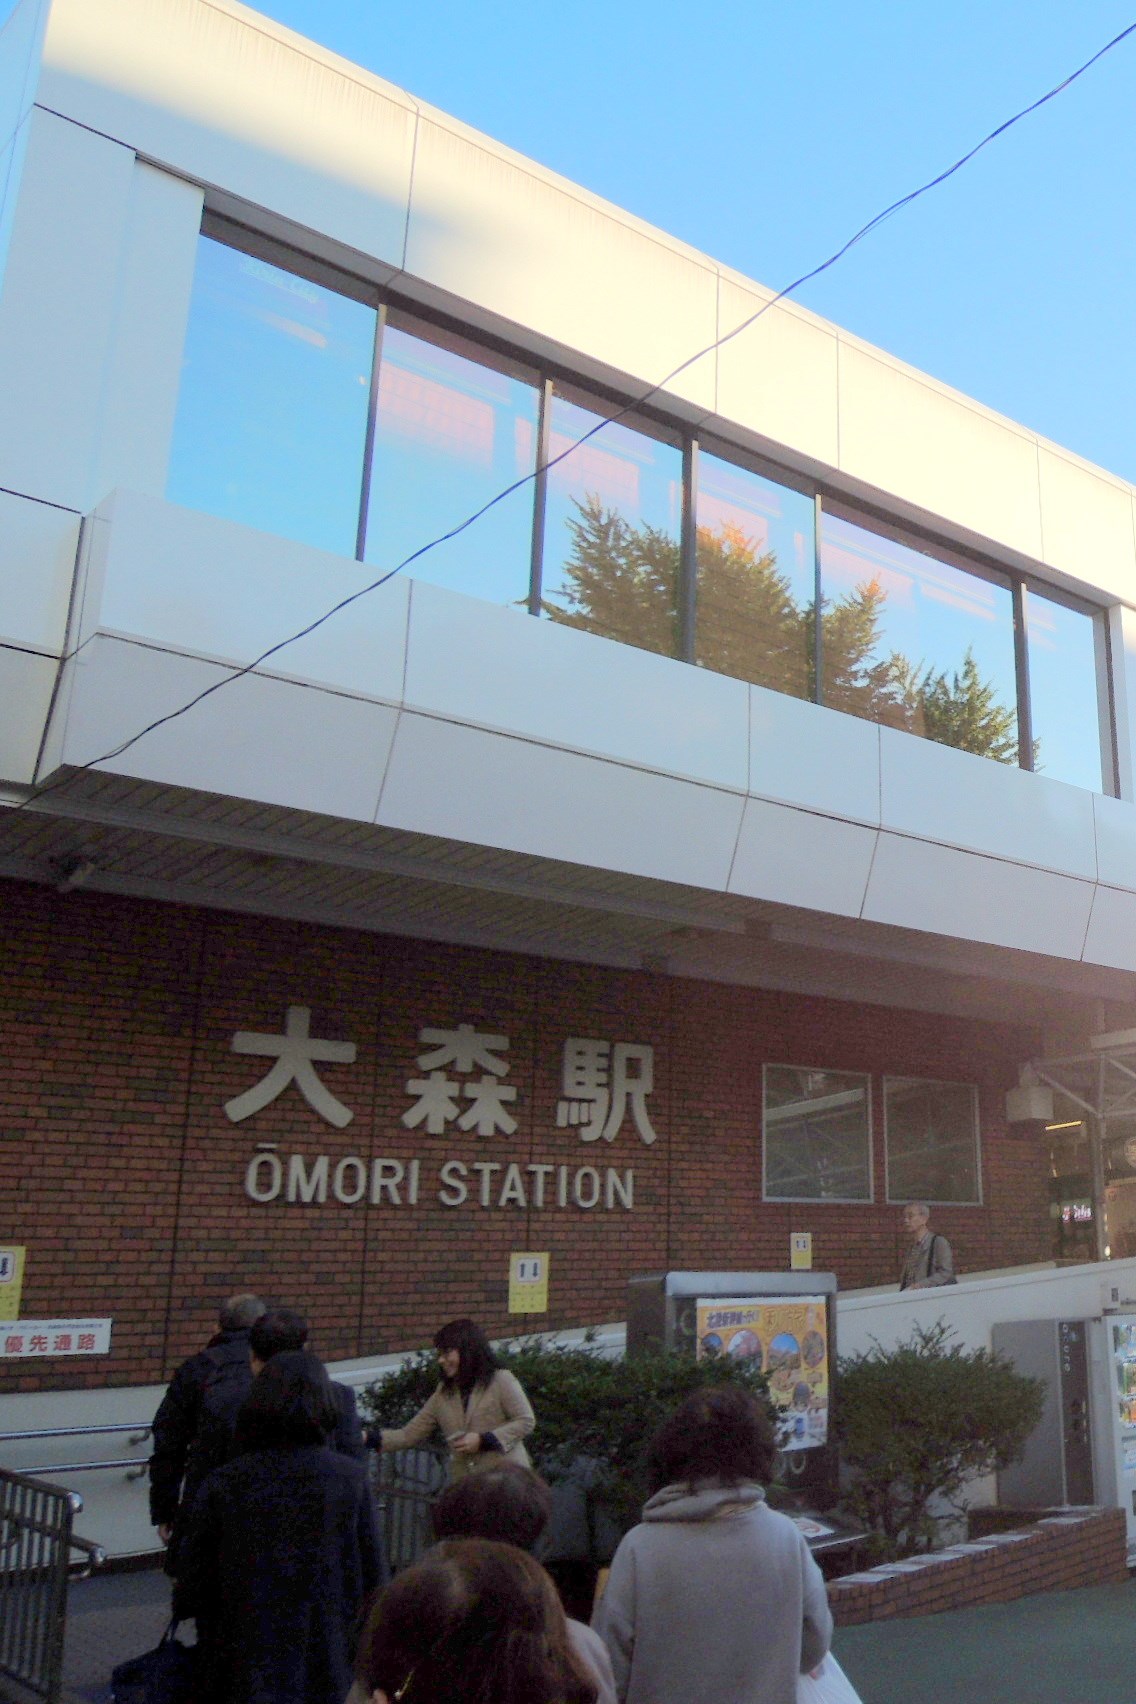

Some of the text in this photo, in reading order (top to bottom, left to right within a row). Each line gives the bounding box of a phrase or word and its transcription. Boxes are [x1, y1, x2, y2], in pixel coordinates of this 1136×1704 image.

[224, 1005, 657, 1145] 大森駅
[245, 1143, 635, 1210] ŌMORI STATION
[4, 1333, 96, 1354] 優先通路
